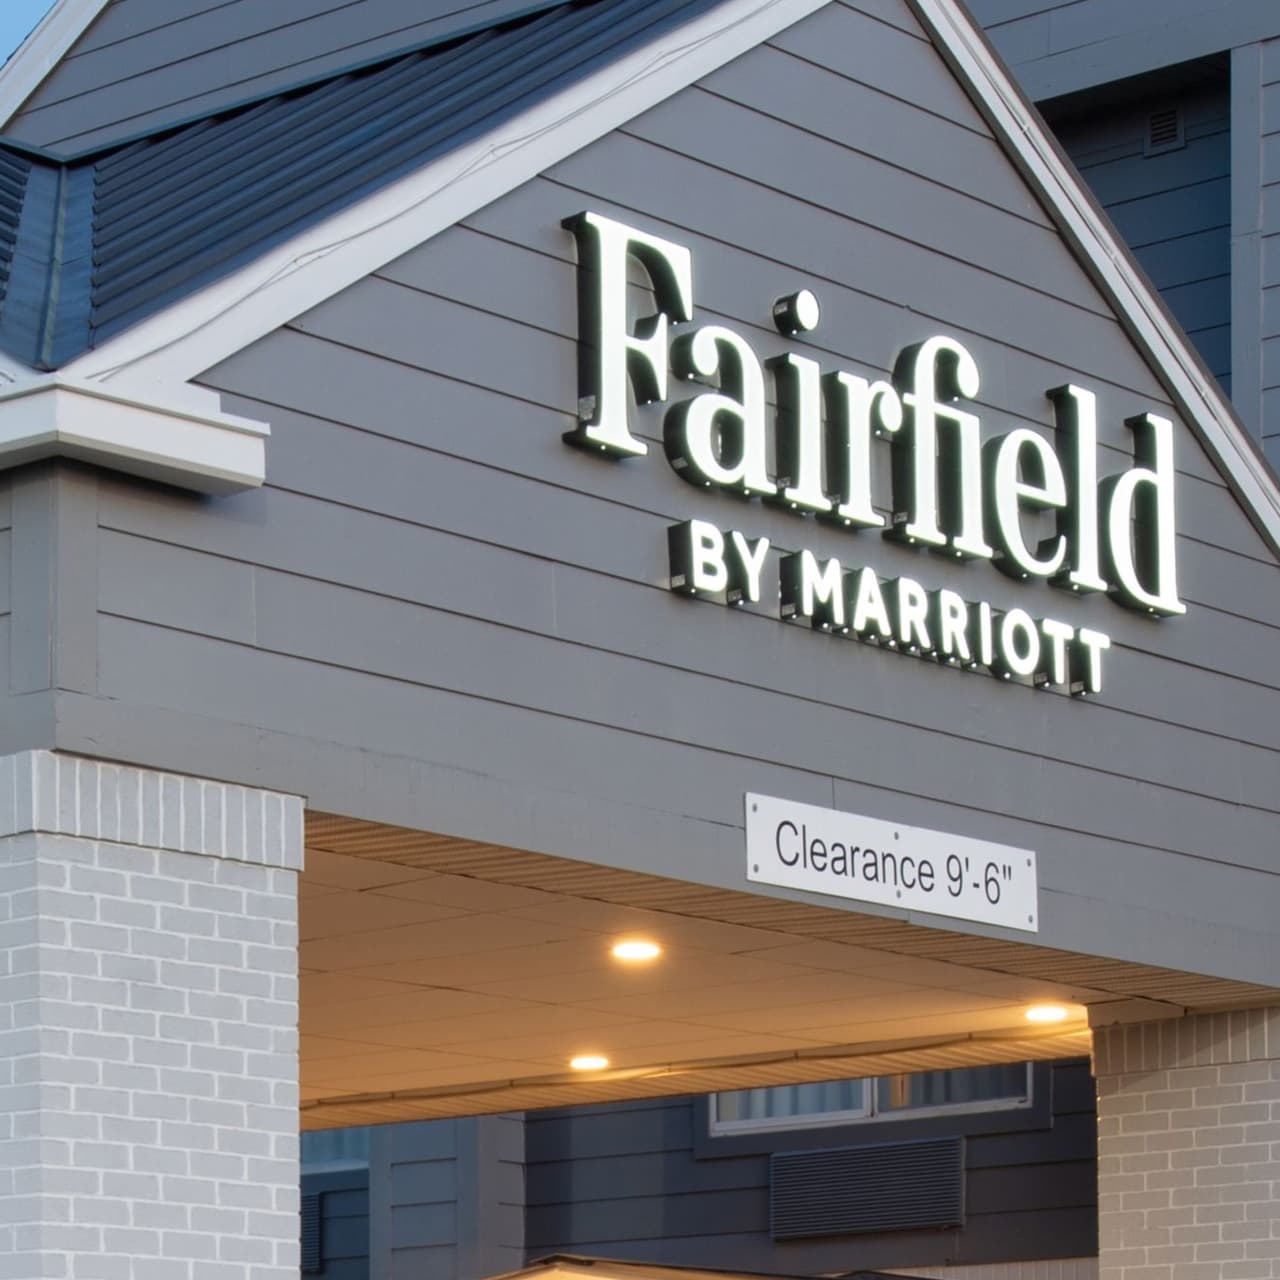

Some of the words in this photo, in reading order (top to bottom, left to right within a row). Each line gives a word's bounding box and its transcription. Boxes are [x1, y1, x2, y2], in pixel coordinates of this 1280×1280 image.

[582, 210, 1188, 616] Fairfield
[688, 518, 771, 603] BY
[800, 548, 1112, 694] MARRIOTT
[774, 819, 936, 894] Clearance
[945, 853, 1013, 906] 9'-6"
